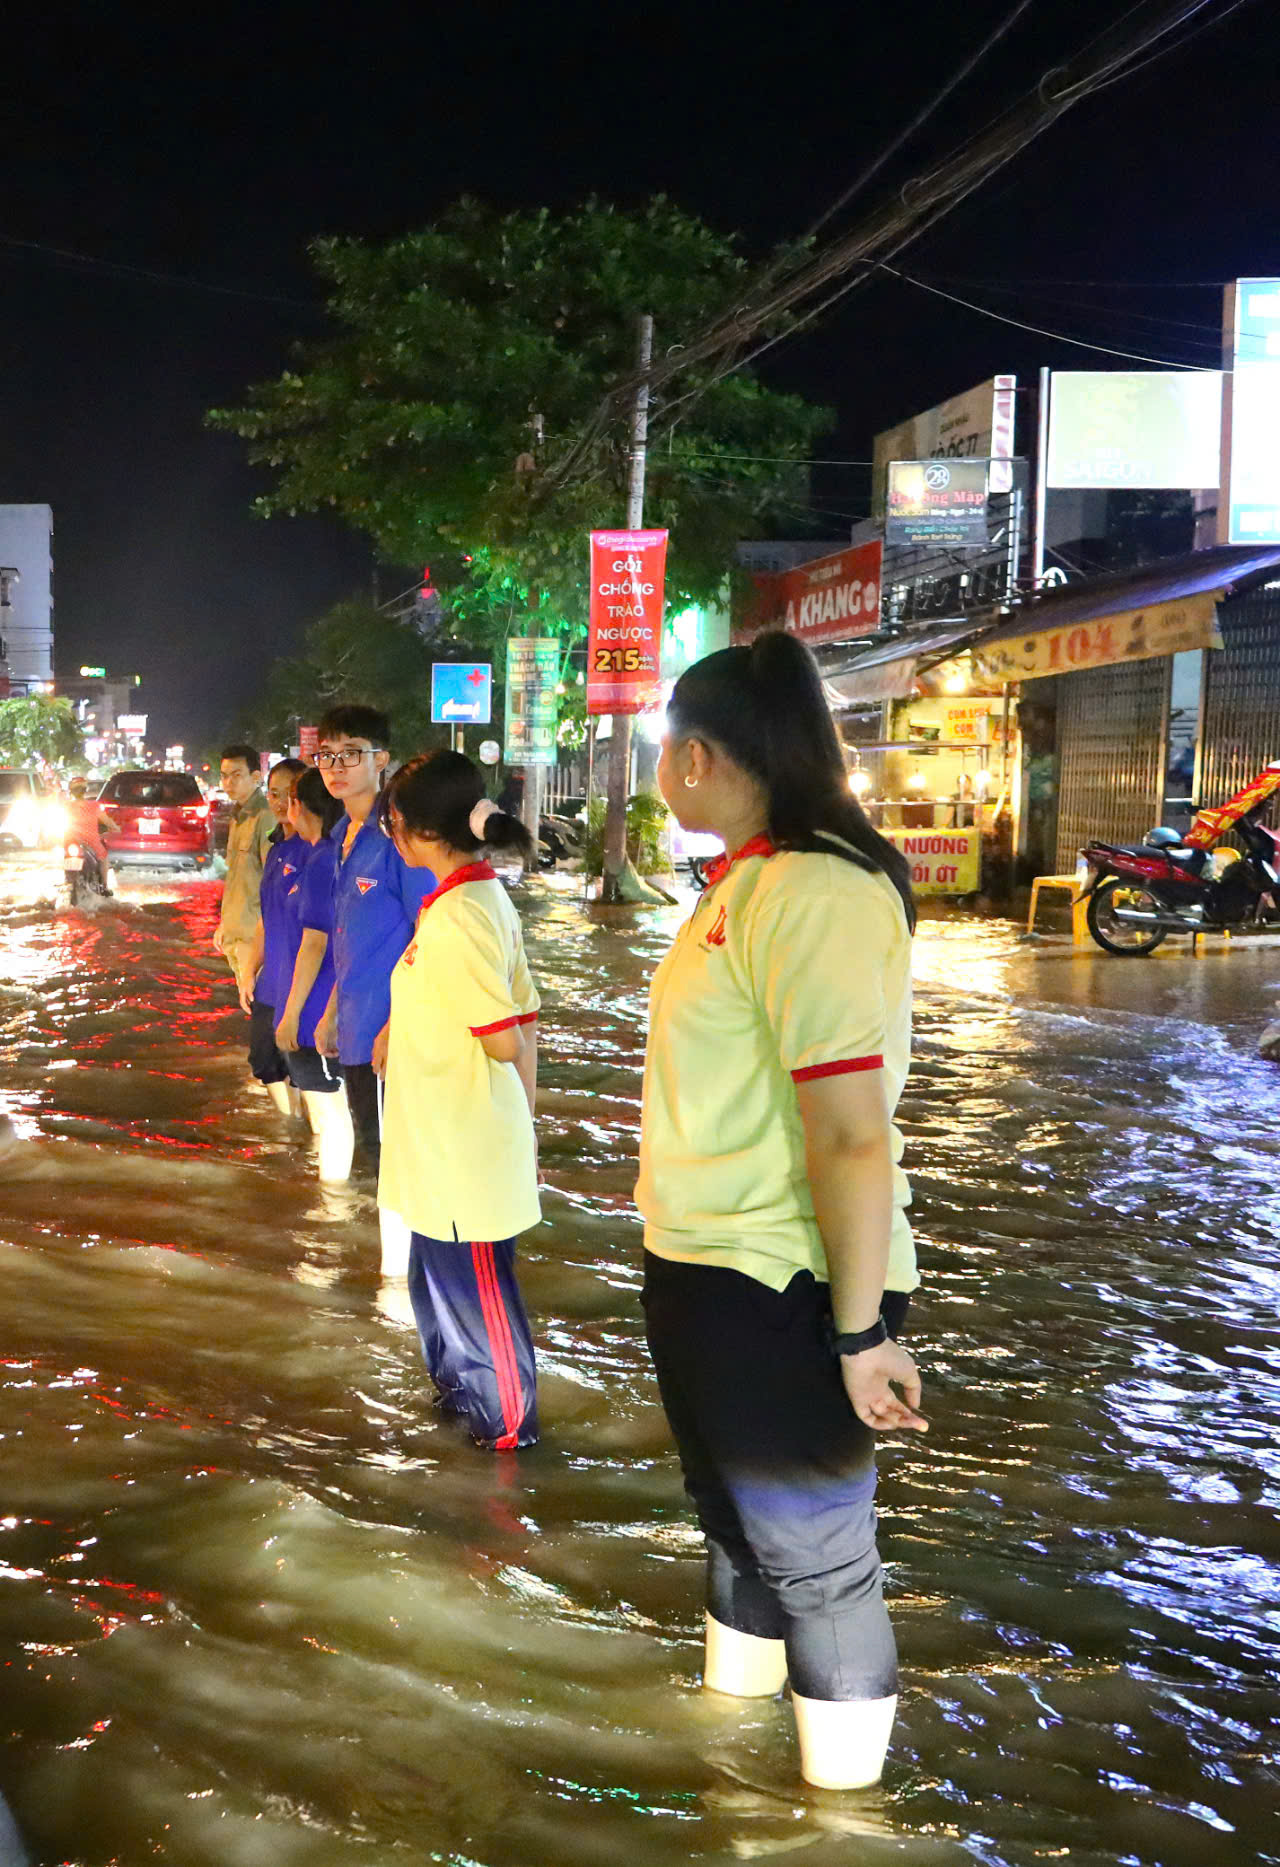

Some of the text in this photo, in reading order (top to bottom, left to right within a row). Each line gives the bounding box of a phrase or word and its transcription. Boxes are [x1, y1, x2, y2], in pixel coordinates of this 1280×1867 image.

[598, 577, 655, 596] CHỐNG
[607, 602, 645, 618] TRÀO
[800, 580, 862, 629] KHANG
[596, 626, 654, 642] NGƯỢC
[595, 648, 640, 672] 215
[904, 835, 969, 855] NƯỚNG
[911, 860, 959, 883] ỐI ỚT
